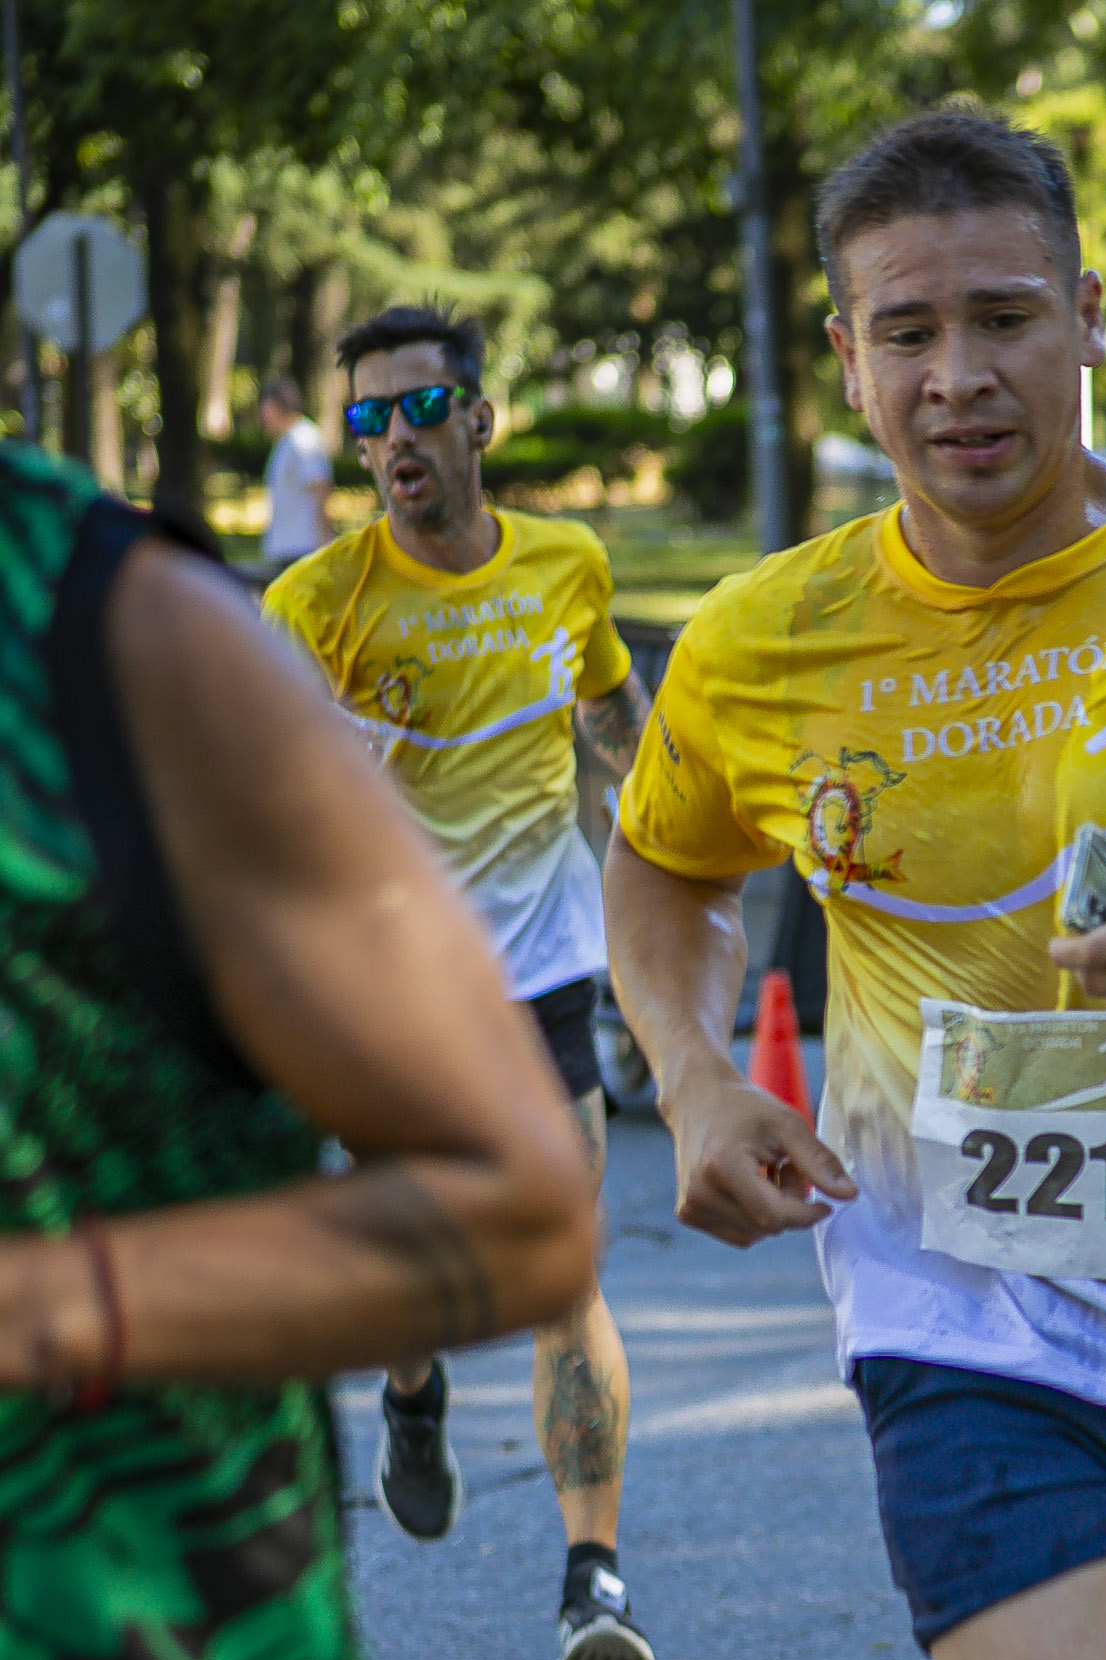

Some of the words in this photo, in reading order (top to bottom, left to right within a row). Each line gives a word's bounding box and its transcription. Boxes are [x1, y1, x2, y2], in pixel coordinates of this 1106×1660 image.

[424, 590, 544, 632] MARATÓN
[428, 626, 530, 664] DORADA
[902, 695, 1092, 763] DORADA
